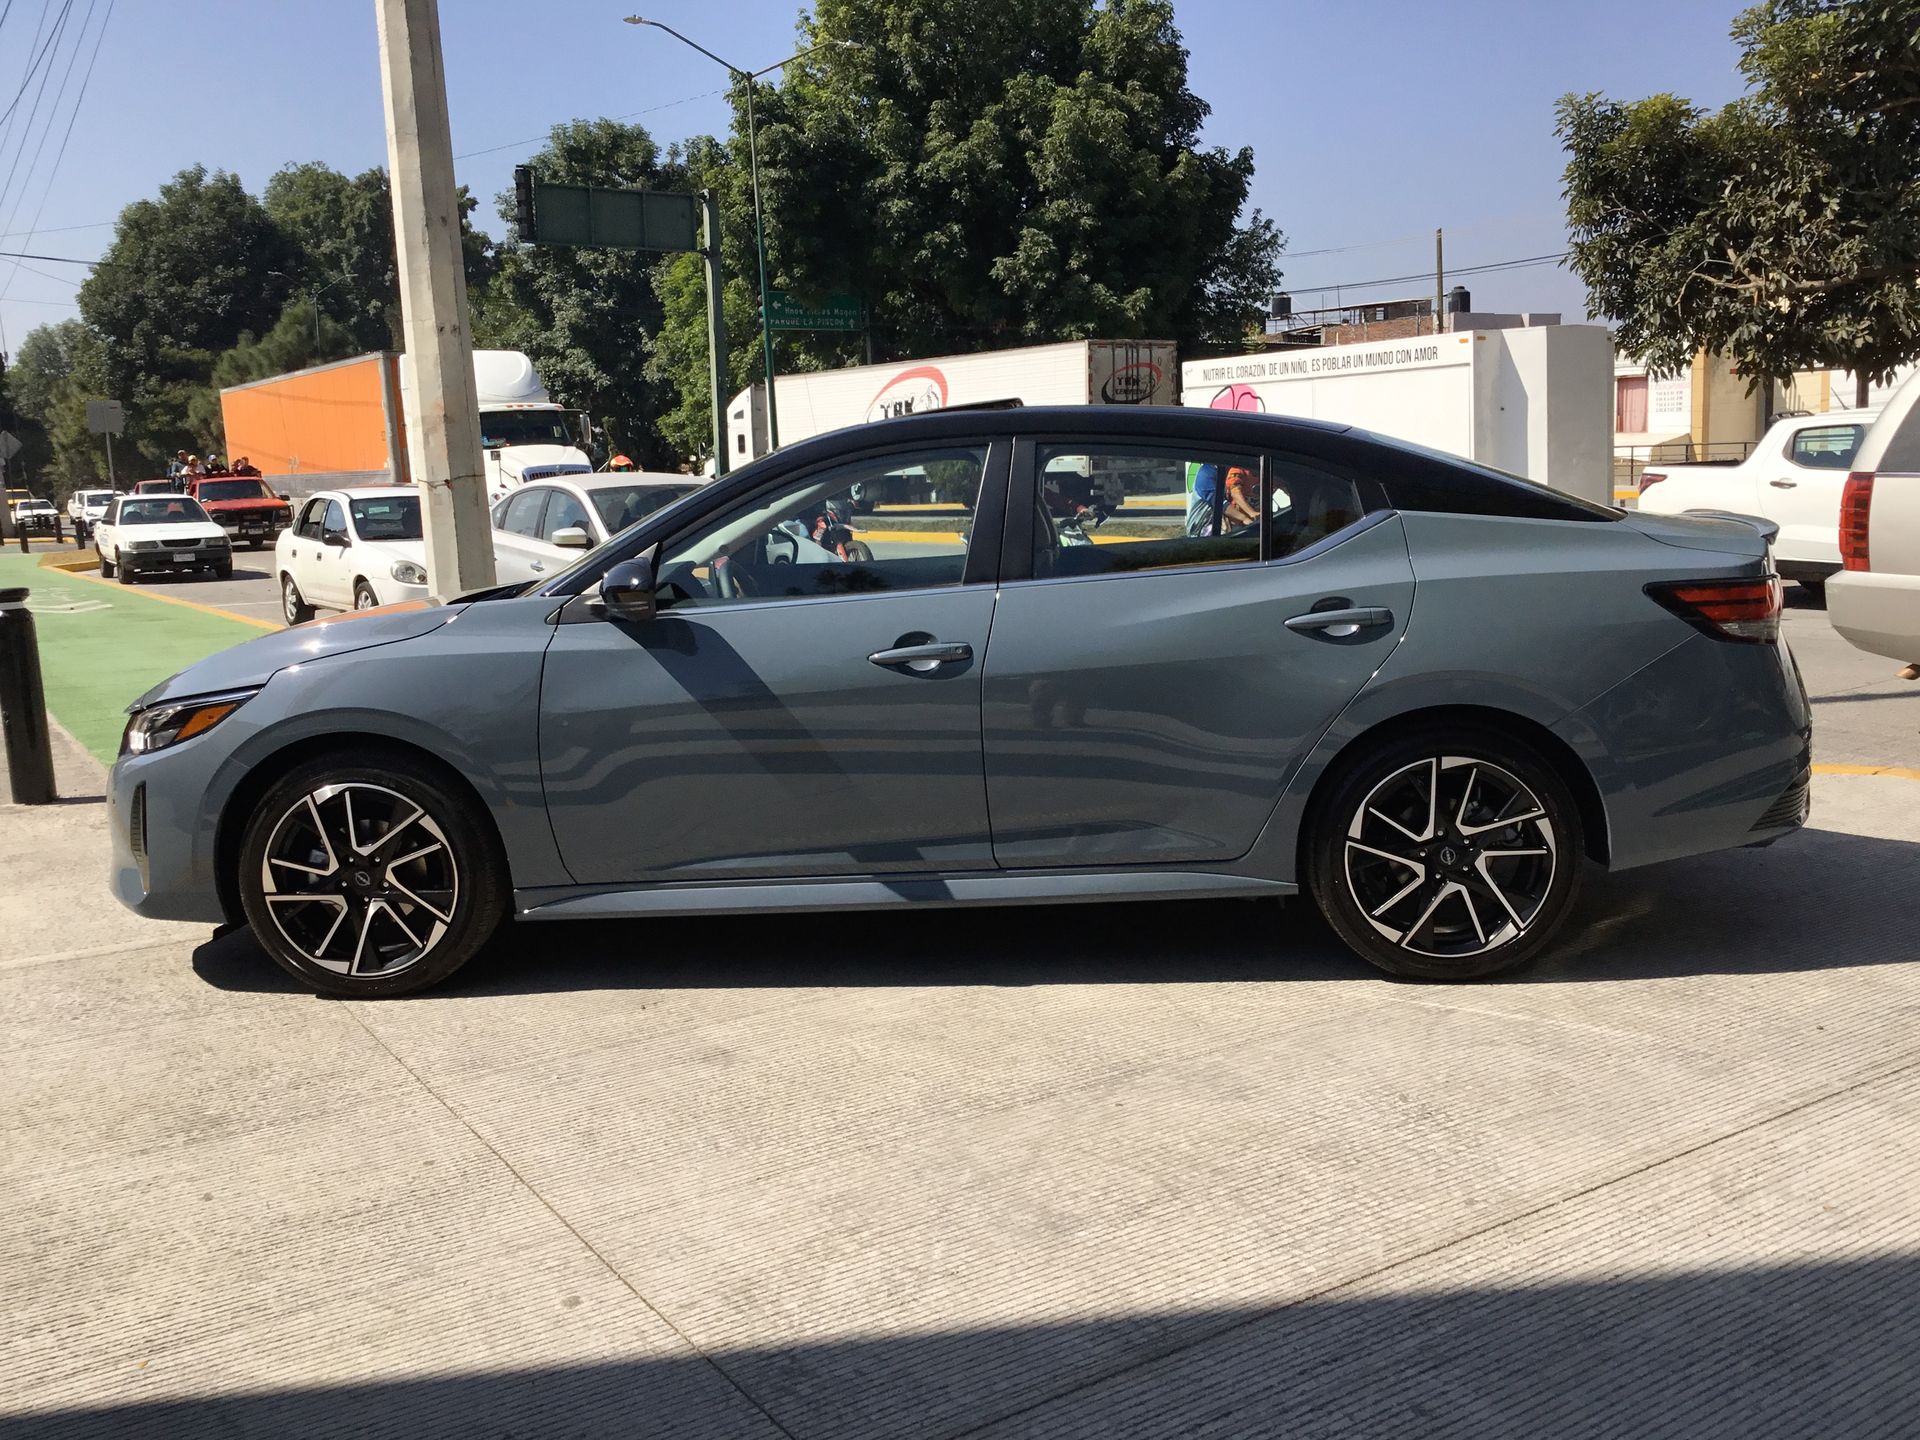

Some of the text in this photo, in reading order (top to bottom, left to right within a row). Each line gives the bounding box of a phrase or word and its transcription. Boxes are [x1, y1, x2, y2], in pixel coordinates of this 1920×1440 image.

[1202, 367, 1226, 381] NUTRIR
[1227, 366, 1235, 379] EL
[1269, 362, 1278, 376] DE
[1279, 361, 1289, 375] UN
[1311, 358, 1321, 372] ES
[1322, 355, 1352, 371] POBLAR
[1353, 354, 1364, 368] UN
[1365, 351, 1393, 367] MUNDO
[1395, 349, 1412, 364] CON
[1413, 346, 1438, 362] AMOR
